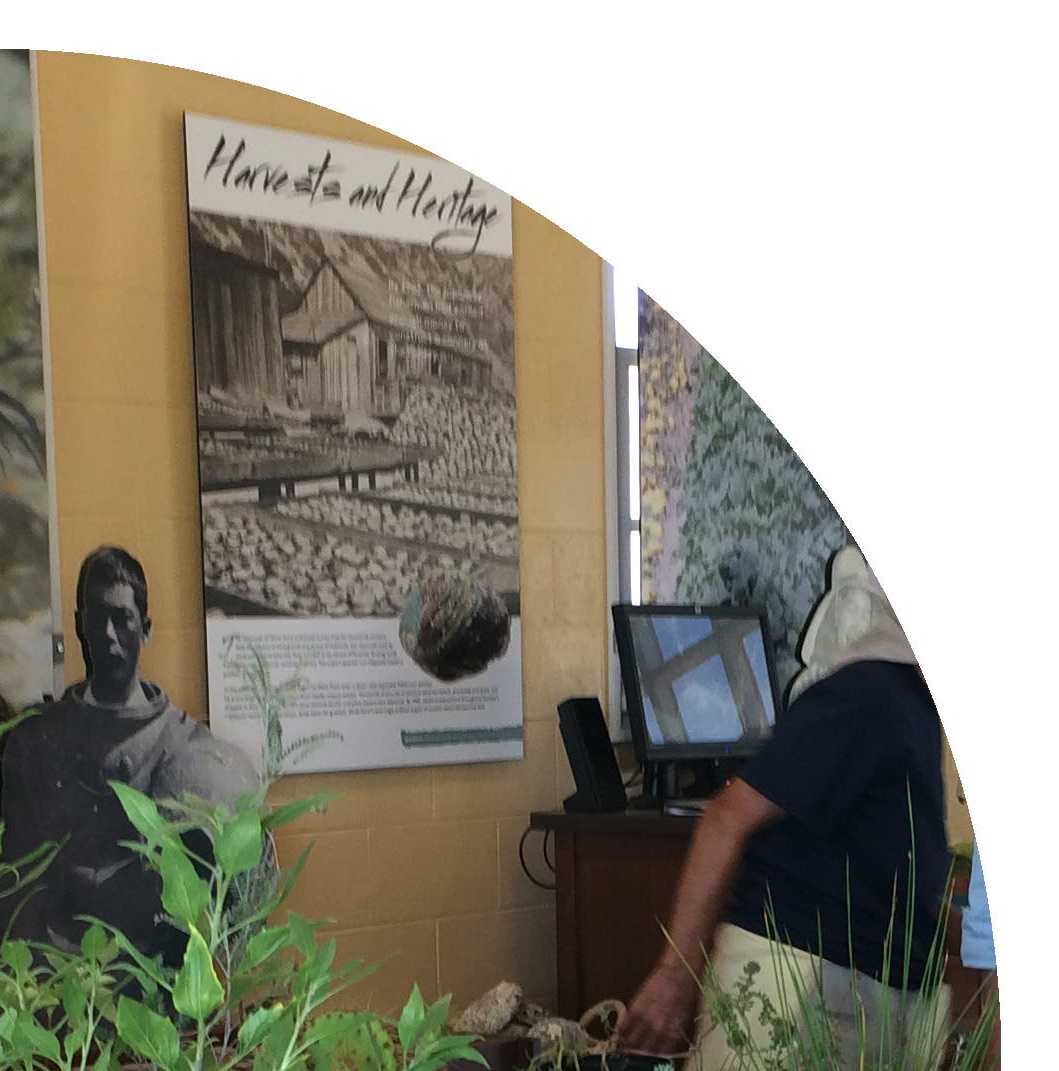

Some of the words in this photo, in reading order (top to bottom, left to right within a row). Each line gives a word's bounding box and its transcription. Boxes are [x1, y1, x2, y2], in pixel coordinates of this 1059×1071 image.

[203, 134, 343, 207] Harvests
[348, 159, 400, 214] and
[396, 168, 498, 255] Heritage
